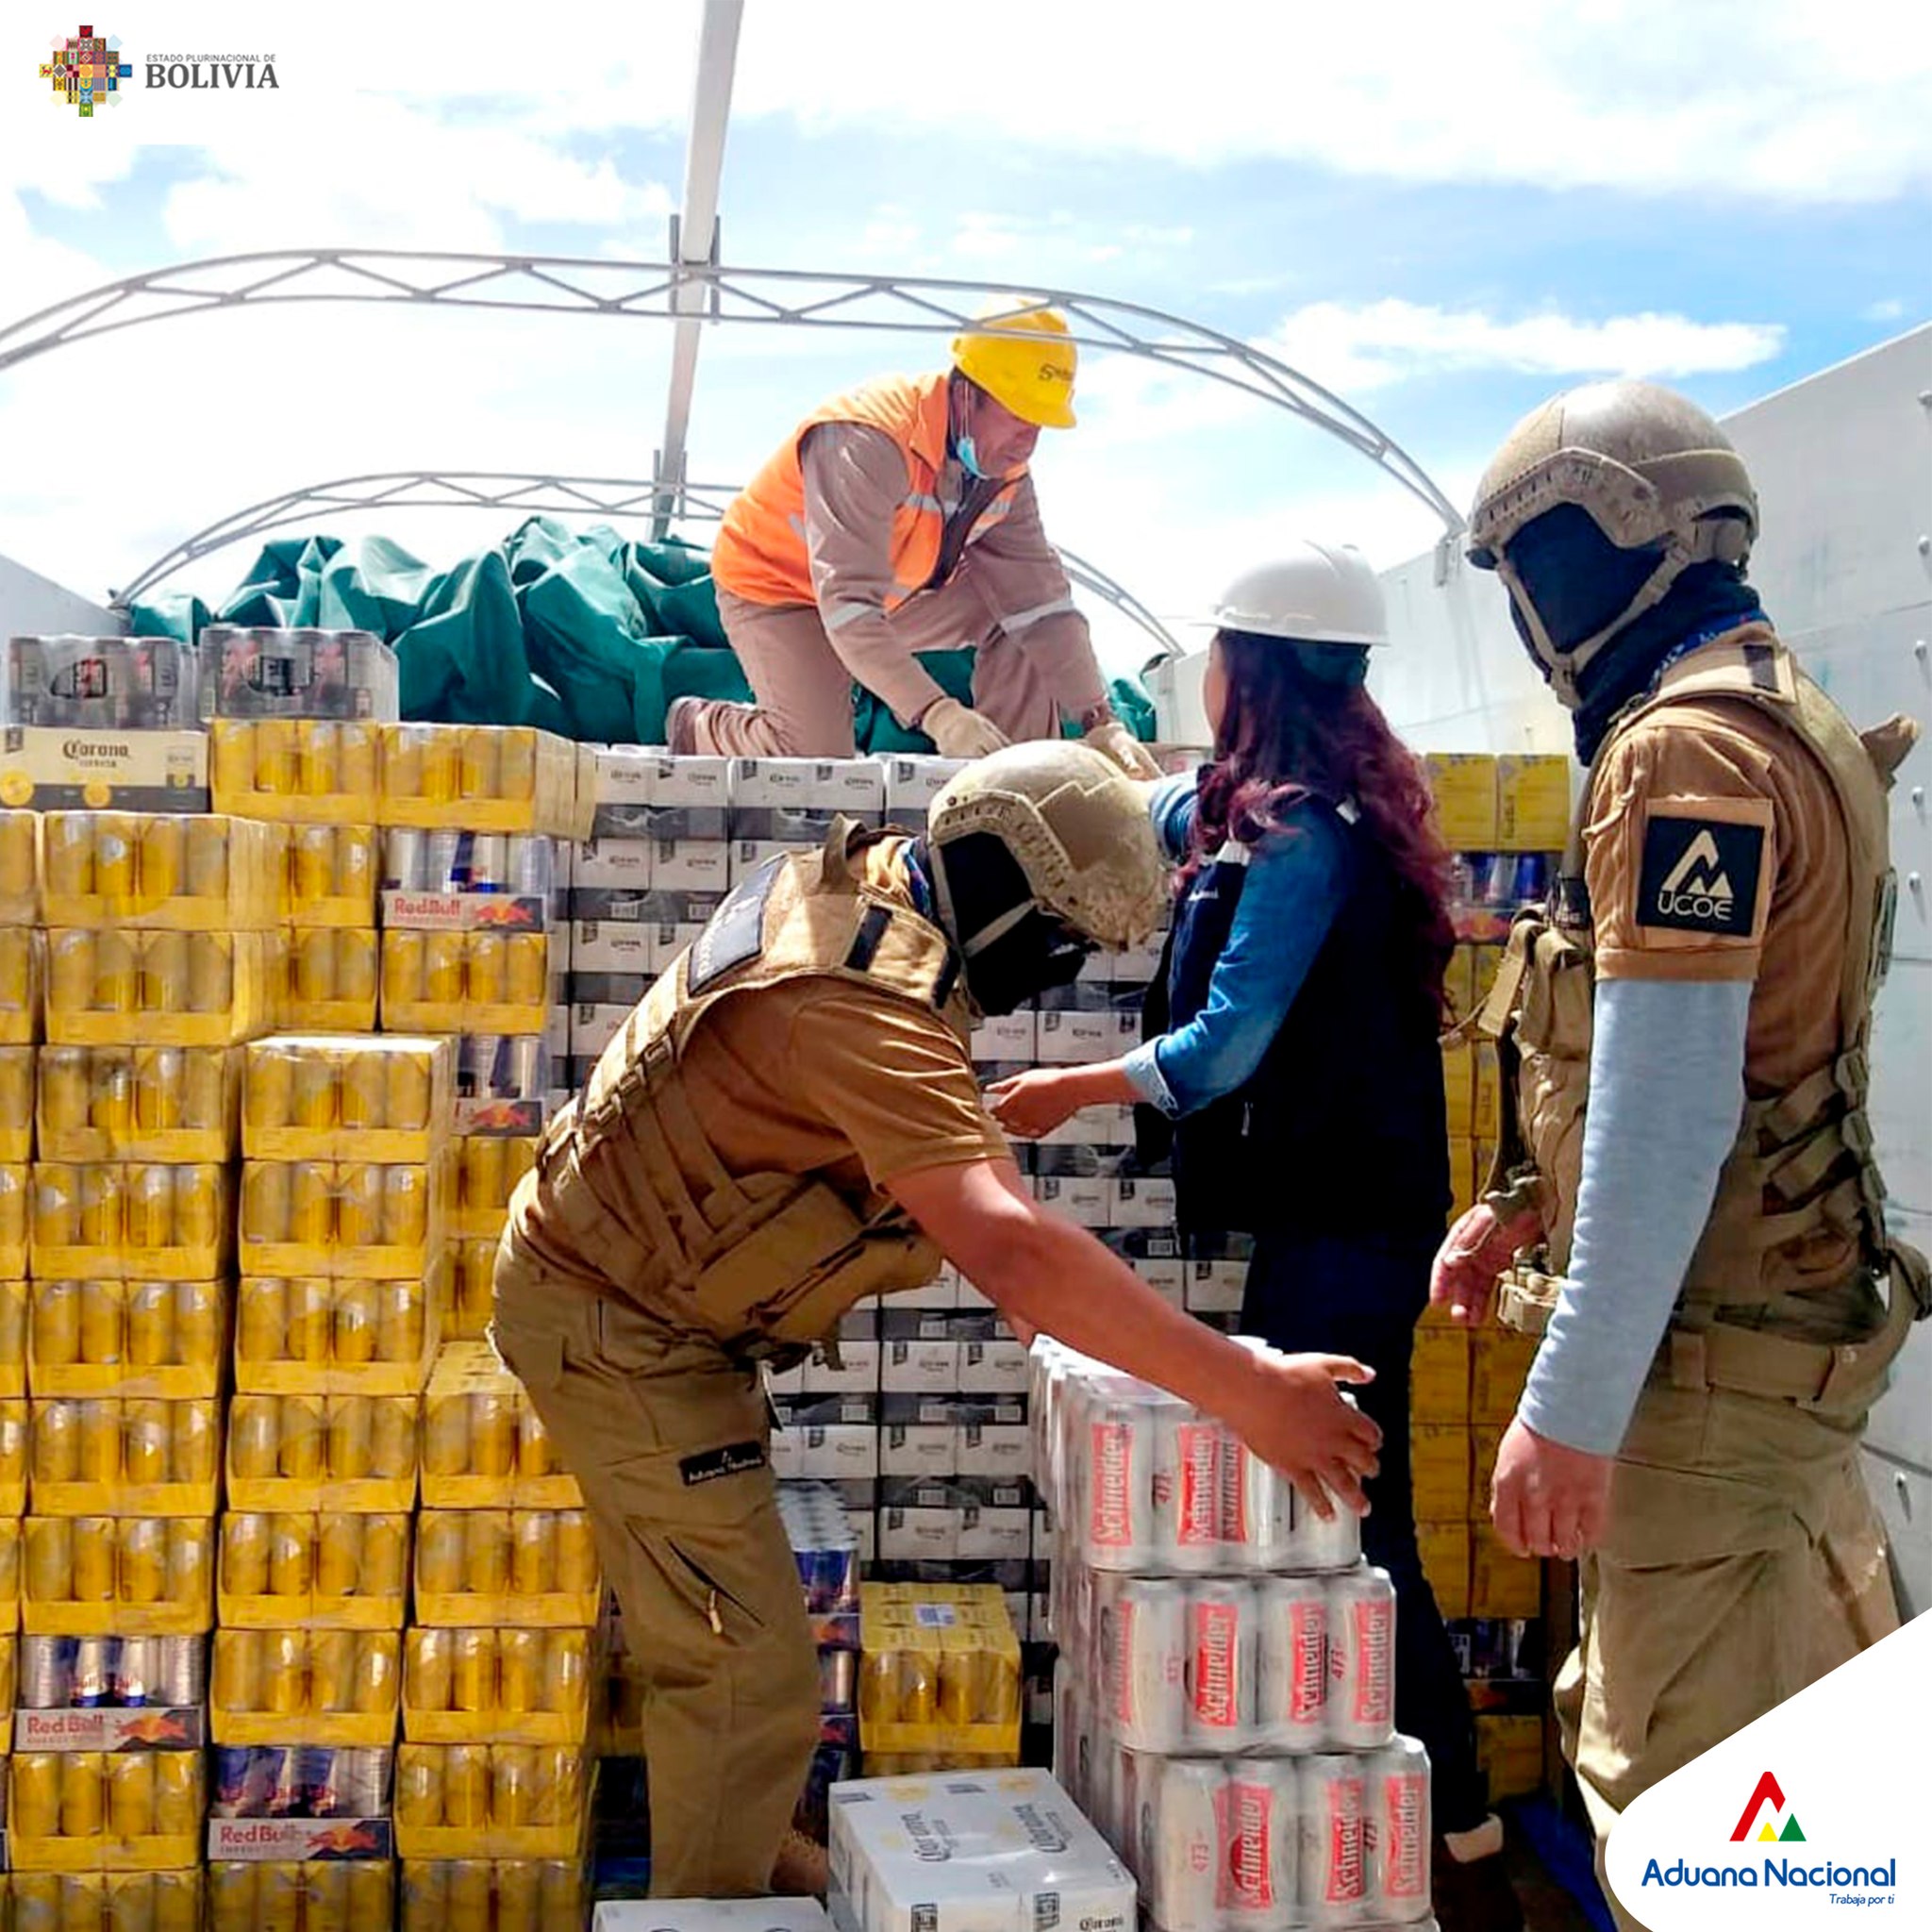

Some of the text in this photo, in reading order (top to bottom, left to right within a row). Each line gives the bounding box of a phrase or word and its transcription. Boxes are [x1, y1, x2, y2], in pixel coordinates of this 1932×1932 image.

[63, 740, 130, 760] Corona
[394, 898, 426, 915] Red
[1657, 892, 1733, 921] UCOE
[26, 1714, 104, 1734] Red Bull
[220, 1825, 257, 1843] Red
